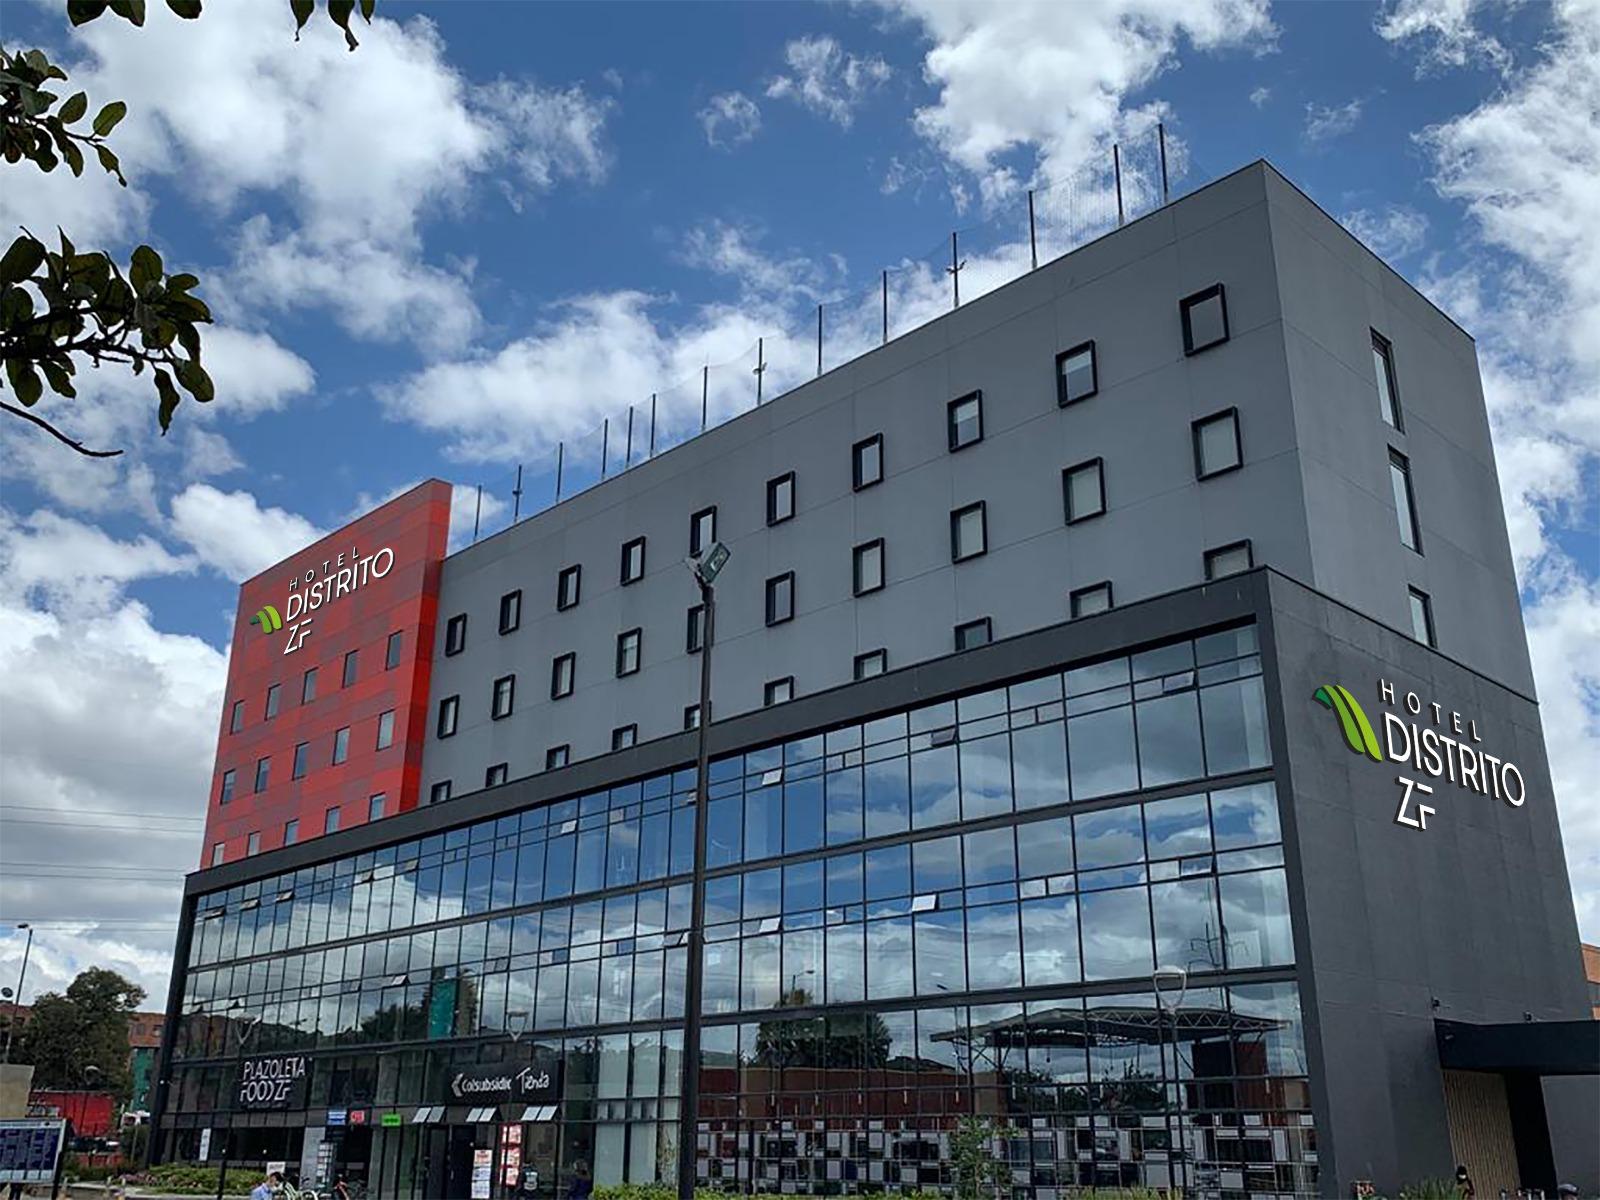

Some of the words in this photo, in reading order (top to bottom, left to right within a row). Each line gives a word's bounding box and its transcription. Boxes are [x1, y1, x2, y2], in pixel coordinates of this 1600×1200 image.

[286, 548, 394, 622] DISTRITO
[289, 547, 359, 591] HOTEL
[284, 618, 312, 654] ZF
[1379, 678, 1482, 742] HOTEL
[1383, 711, 1526, 807] DISTRITO
[1395, 775, 1436, 830] ZF
[243, 1057, 306, 1080] PLAZOLETA
[516, 1066, 550, 1095] Tienda
